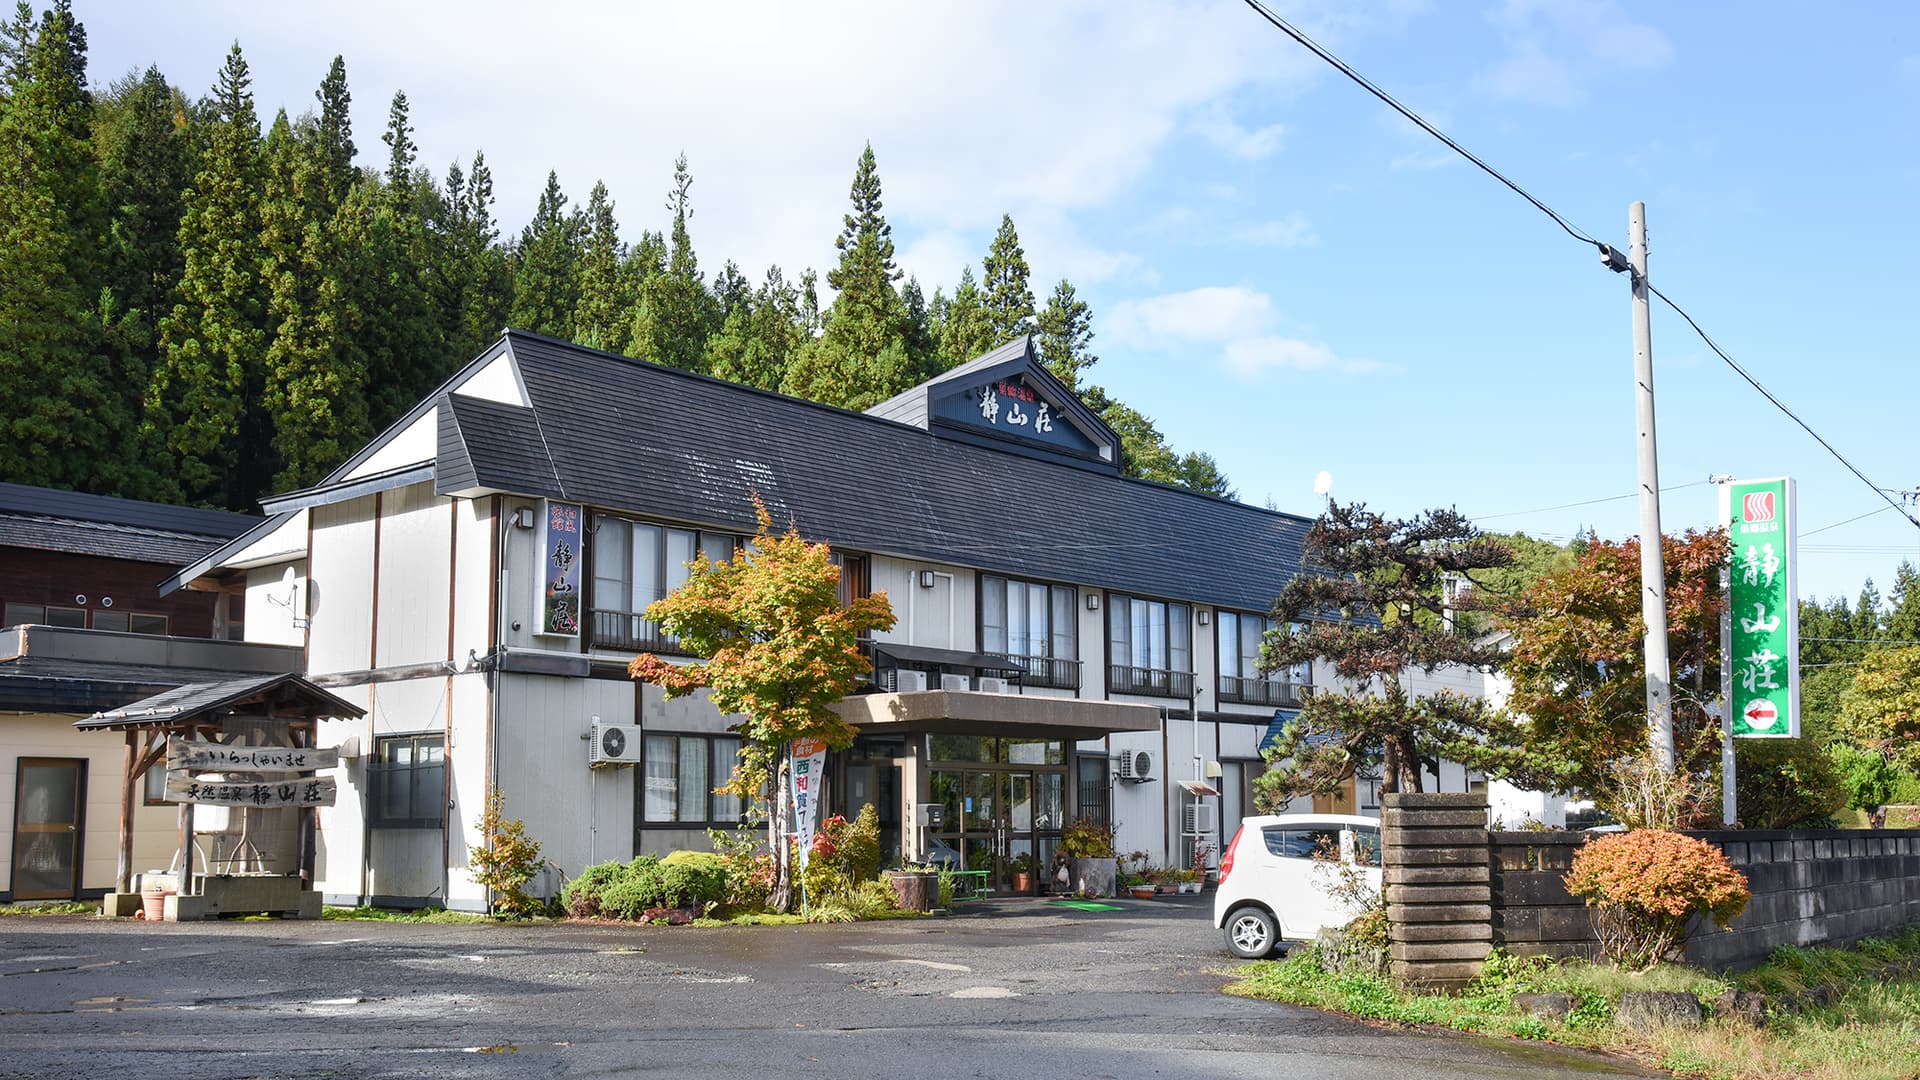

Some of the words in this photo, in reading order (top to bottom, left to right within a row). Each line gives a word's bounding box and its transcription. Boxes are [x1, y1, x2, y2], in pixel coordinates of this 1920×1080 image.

[1739, 543, 1780, 692] 静山荘
[209, 751, 305, 768] いらっしゃいませ
